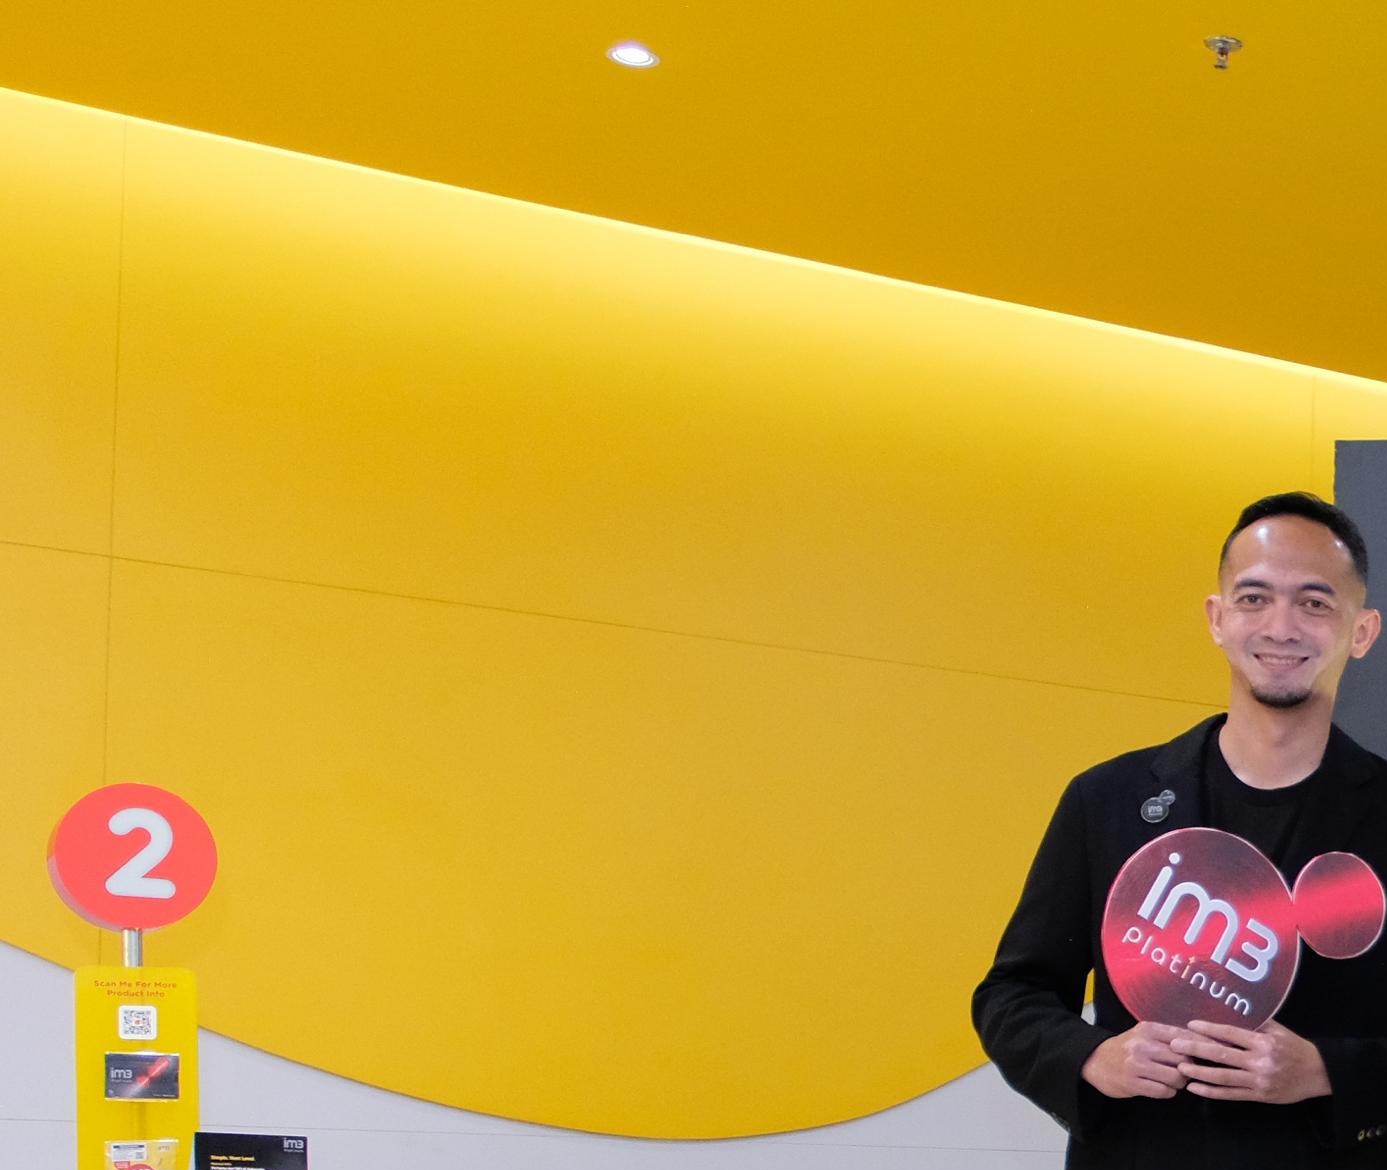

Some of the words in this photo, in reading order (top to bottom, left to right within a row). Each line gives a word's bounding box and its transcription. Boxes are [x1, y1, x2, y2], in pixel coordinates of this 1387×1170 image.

[105, 807, 176, 899] 2
[1137, 852, 1279, 982] im3
[94, 980, 117, 988] Scan
[153, 981, 177, 989] More
[106, 989, 144, 998] Product
[146, 990, 165, 998] Info
